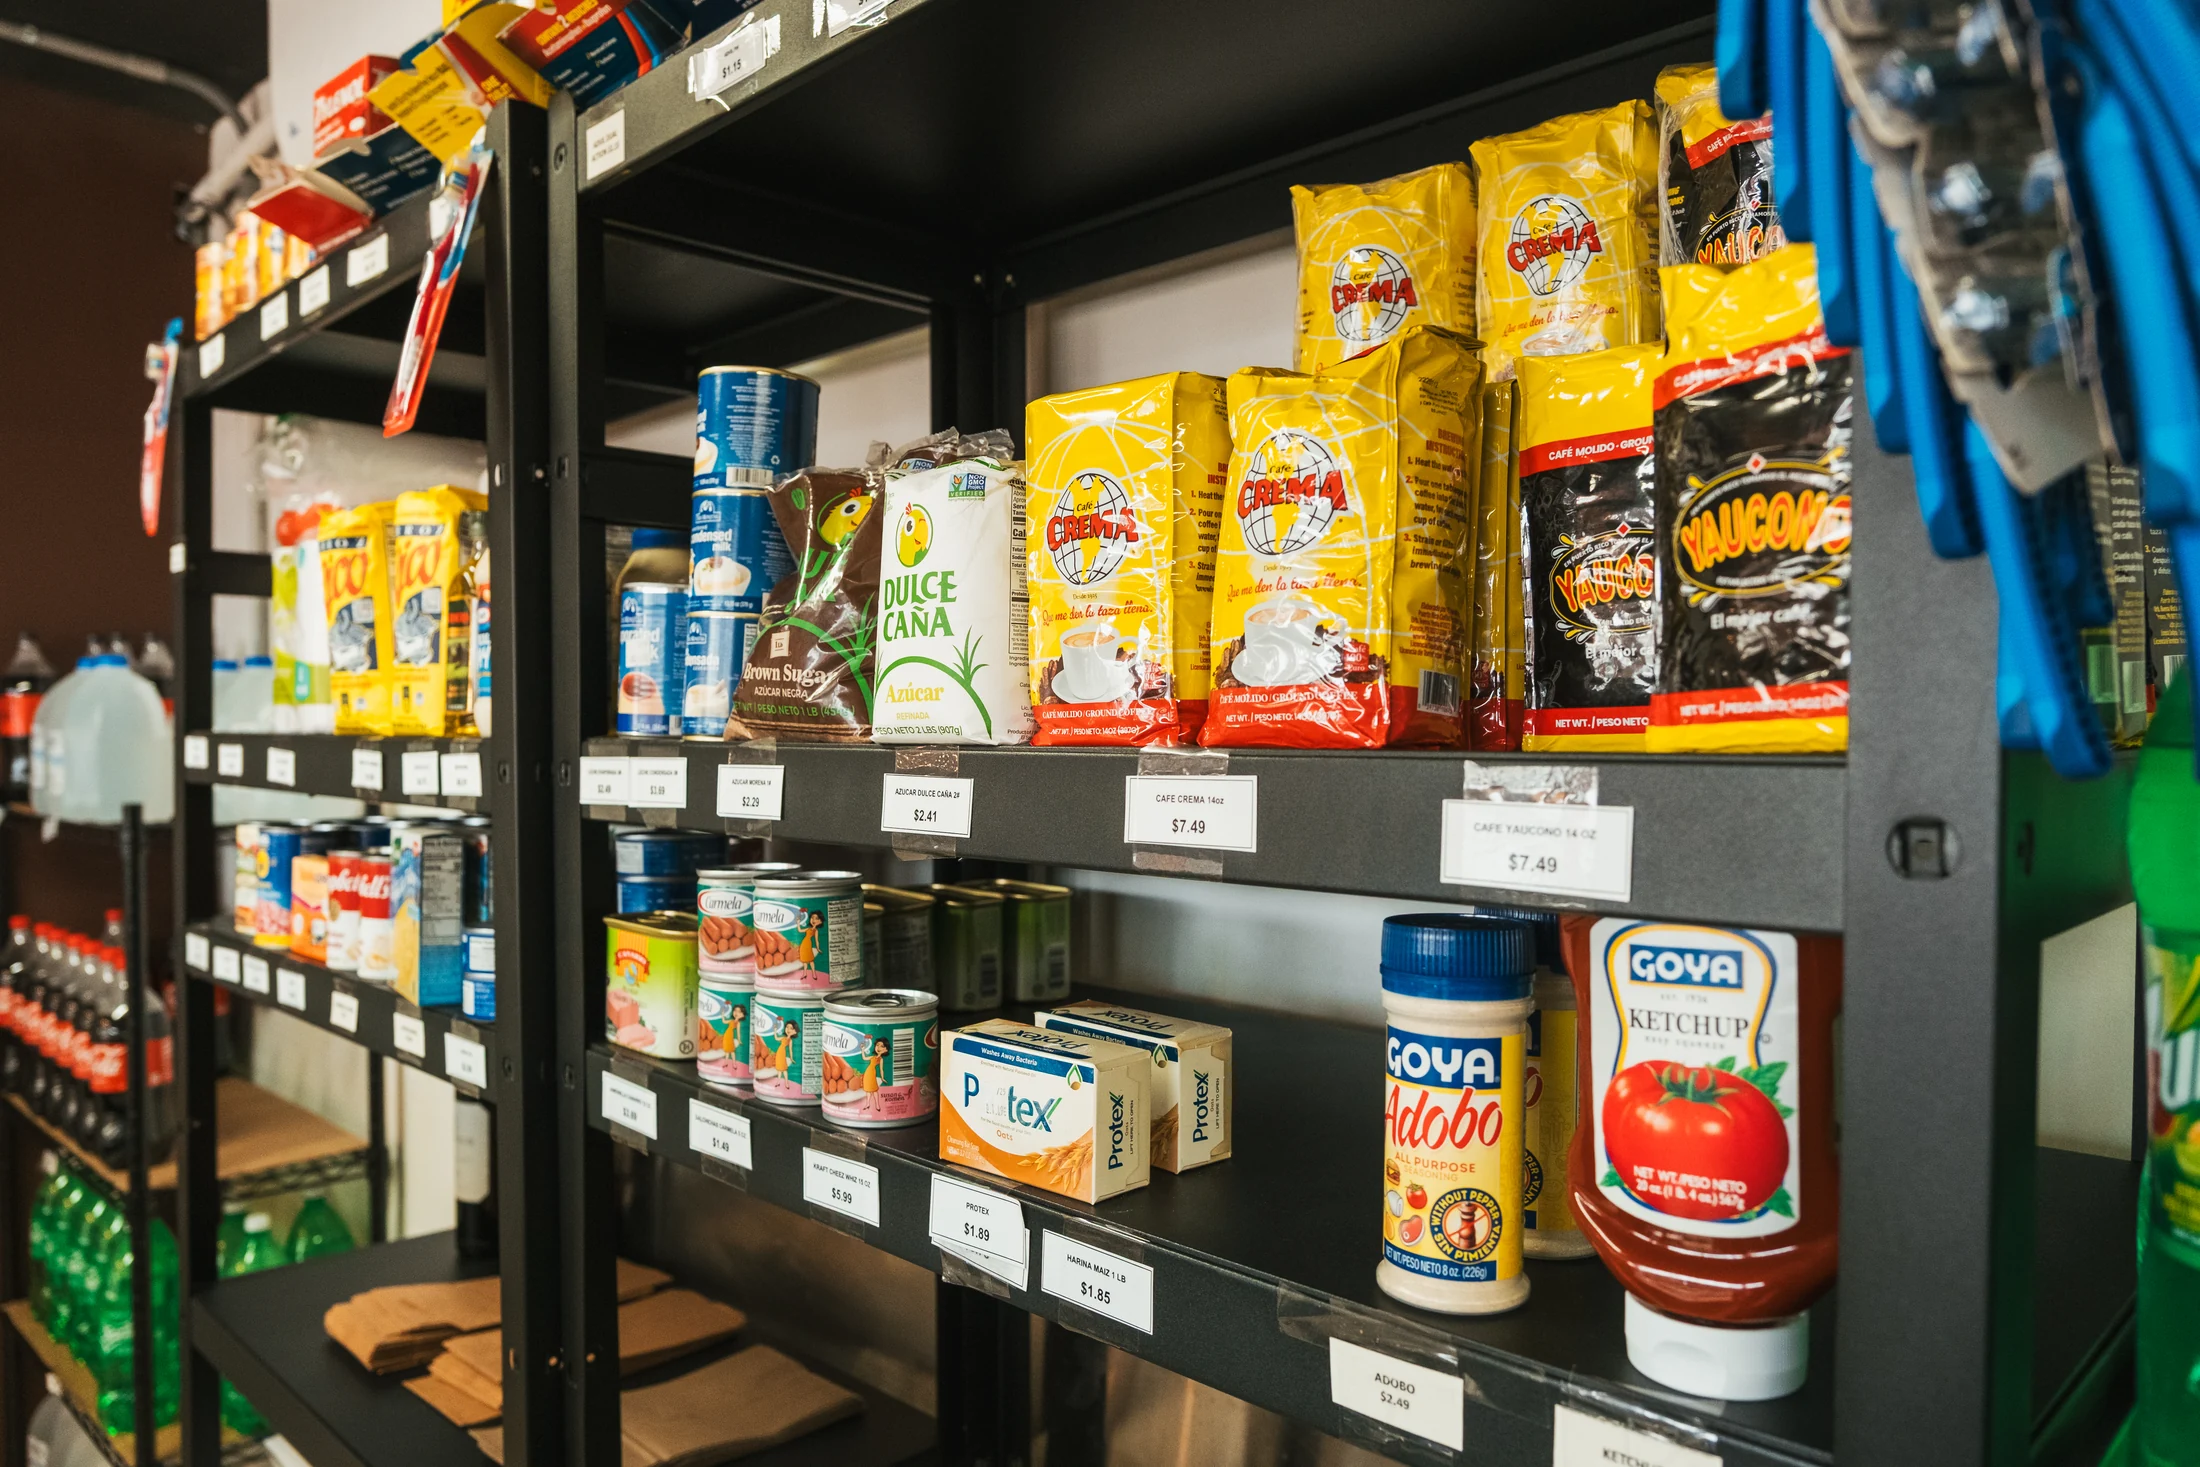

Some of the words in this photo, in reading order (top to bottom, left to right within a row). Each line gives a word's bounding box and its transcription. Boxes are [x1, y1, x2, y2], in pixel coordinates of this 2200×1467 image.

[722, 58, 741, 79] $1.15
[1533, 223, 1551, 235] Café
[1507, 220, 1602, 272] CREMA
[1353, 272, 1371, 281] Café
[1332, 277, 1418, 314] CREMA
[1548, 446, 1573, 461] CAFÉ
[1575, 442, 1615, 457] MOLIDO
[968, 473, 986, 481] NON
[1269, 464, 1291, 474] Café
[949, 490, 984, 498] VERIFIED
[1190, 490, 1197, 498] 1.
[1198, 490, 1213, 500] Heat
[1237, 469, 1349, 519] CREMA
[1076, 501, 1094, 512] Café
[1189, 508, 1196, 516] 2.
[1198, 508, 1214, 518] Pour
[1047, 507, 1140, 551] CREMA
[1198, 519, 1218, 530] coffee
[1197, 531, 1217, 542] water,
[1197, 545, 1210, 554] cup
[1563, 557, 1572, 568] EN
[1571, 543, 1595, 562] PUERTO
[1188, 560, 1196, 569] 3.
[884, 570, 958, 611] DULCE
[1241, 585, 1253, 595] me
[1254, 579, 1273, 593] den
[1276, 576, 1287, 590] la
[1055, 611, 1068, 622] me
[1097, 604, 1121, 618] taza
[883, 605, 956, 643] CAÑA
[743, 662, 780, 682] Brown
[754, 685, 781, 697] AZÚCAR
[782, 687, 809, 698] NEGRA
[885, 681, 945, 704] Azúcar
[757, 703, 776, 714] PESO
[778, 706, 800, 716] NETO
[807, 706, 819, 716] LB
[896, 711, 930, 721] REFINADA
[1042, 709, 1057, 719] CAFÉ
[1057, 709, 1082, 719] MOLIDO
[1085, 709, 1117, 719] GROUND
[1254, 713, 1273, 722] PESO
[894, 726, 914, 735] NETO
[915, 726, 921, 735] 2
[922, 725, 937, 735] LBS
[937, 725, 963, 736] (907g)
[1555, 717, 1571, 728] NET
[1572, 717, 1591, 727] WT.
[1596, 716, 1624, 727] PESO
[1623, 716, 1649, 727] NETO
[732, 778, 748, 786] AZUCAR
[742, 796, 760, 808] $2.29
[895, 787, 917, 798] AZUCAR
[918, 789, 937, 798] DULCE
[936, 788, 953, 799] CAÑA
[1156, 793, 1176, 804] CAFE
[1177, 794, 1205, 804] CREMA
[1206, 795, 1225, 805] 14oz
[913, 809, 938, 823] $2.41
[1171, 818, 1206, 835] $7.49
[1474, 822, 1503, 834] CAFE
[1505, 823, 1563, 838] YAUCONO
[1566, 828, 1578, 839] 14
[1580, 829, 1598, 840] OZ
[1508, 853, 1558, 874] $7.49
[705, 895, 742, 910] Carmela
[1632, 949, 1739, 985] GOYA
[1629, 1008, 1750, 1038] KETCHUP
[1072, 1028, 1091, 1037] Washes
[1091, 1031, 1105, 1040] Away
[981, 1047, 1000, 1058] Washes
[1001, 1051, 1015, 1062] Away
[1016, 1055, 1038, 1067] Bacteria
[1387, 1036, 1495, 1084] GOYA
[1192, 1069, 1209, 1143] Protex
[1385, 1084, 1503, 1150] Adobo
[996, 1129, 1013, 1141] Oats
[1108, 1091, 1124, 1170] Protex
[712, 1137, 730, 1153] $1.49
[1394, 1151, 1411, 1166] ALL
[1414, 1156, 1476, 1173] PURPOSE
[813, 1163, 829, 1173] KRAFT
[829, 1168, 845, 1180] CHEEZ
[845, 1173, 858, 1184] WHIZ
[864, 1180, 871, 1189] OZ
[1403, 1166, 1459, 1183] SEASONING
[1633, 1165, 1655, 1179] NET
[1712, 1178, 1748, 1194] NETO
[832, 1187, 852, 1204] $5.99
[1635, 1178, 1648, 1191] 20
[1689, 1190, 1698, 1201] 4
[1718, 1193, 1746, 1211] 567g
[965, 1202, 990, 1216] PROTEX
[1431, 1189, 1467, 1226] WITHOUT
[1469, 1190, 1500, 1220] PEPPER
[963, 1222, 990, 1242] $1.89
[1434, 1232, 1452, 1259] SIN
[1454, 1225, 1501, 1262] PIMIENTA
[1066, 1253, 1093, 1271] HARINA
[1093, 1264, 1110, 1278] MAIZ
[1111, 1271, 1116, 1280] 1
[1116, 1272, 1127, 1284] LB
[1421, 1260, 1441, 1275] NETO
[1442, 1264, 1449, 1277] 8
[1449, 1267, 1462, 1278] oz.
[1462, 1266, 1488, 1280] (226g)
[1080, 1281, 1111, 1305] $1.85
[1374, 1372, 1417, 1395] ADOBO
[1379, 1390, 1411, 1411] $2.49
